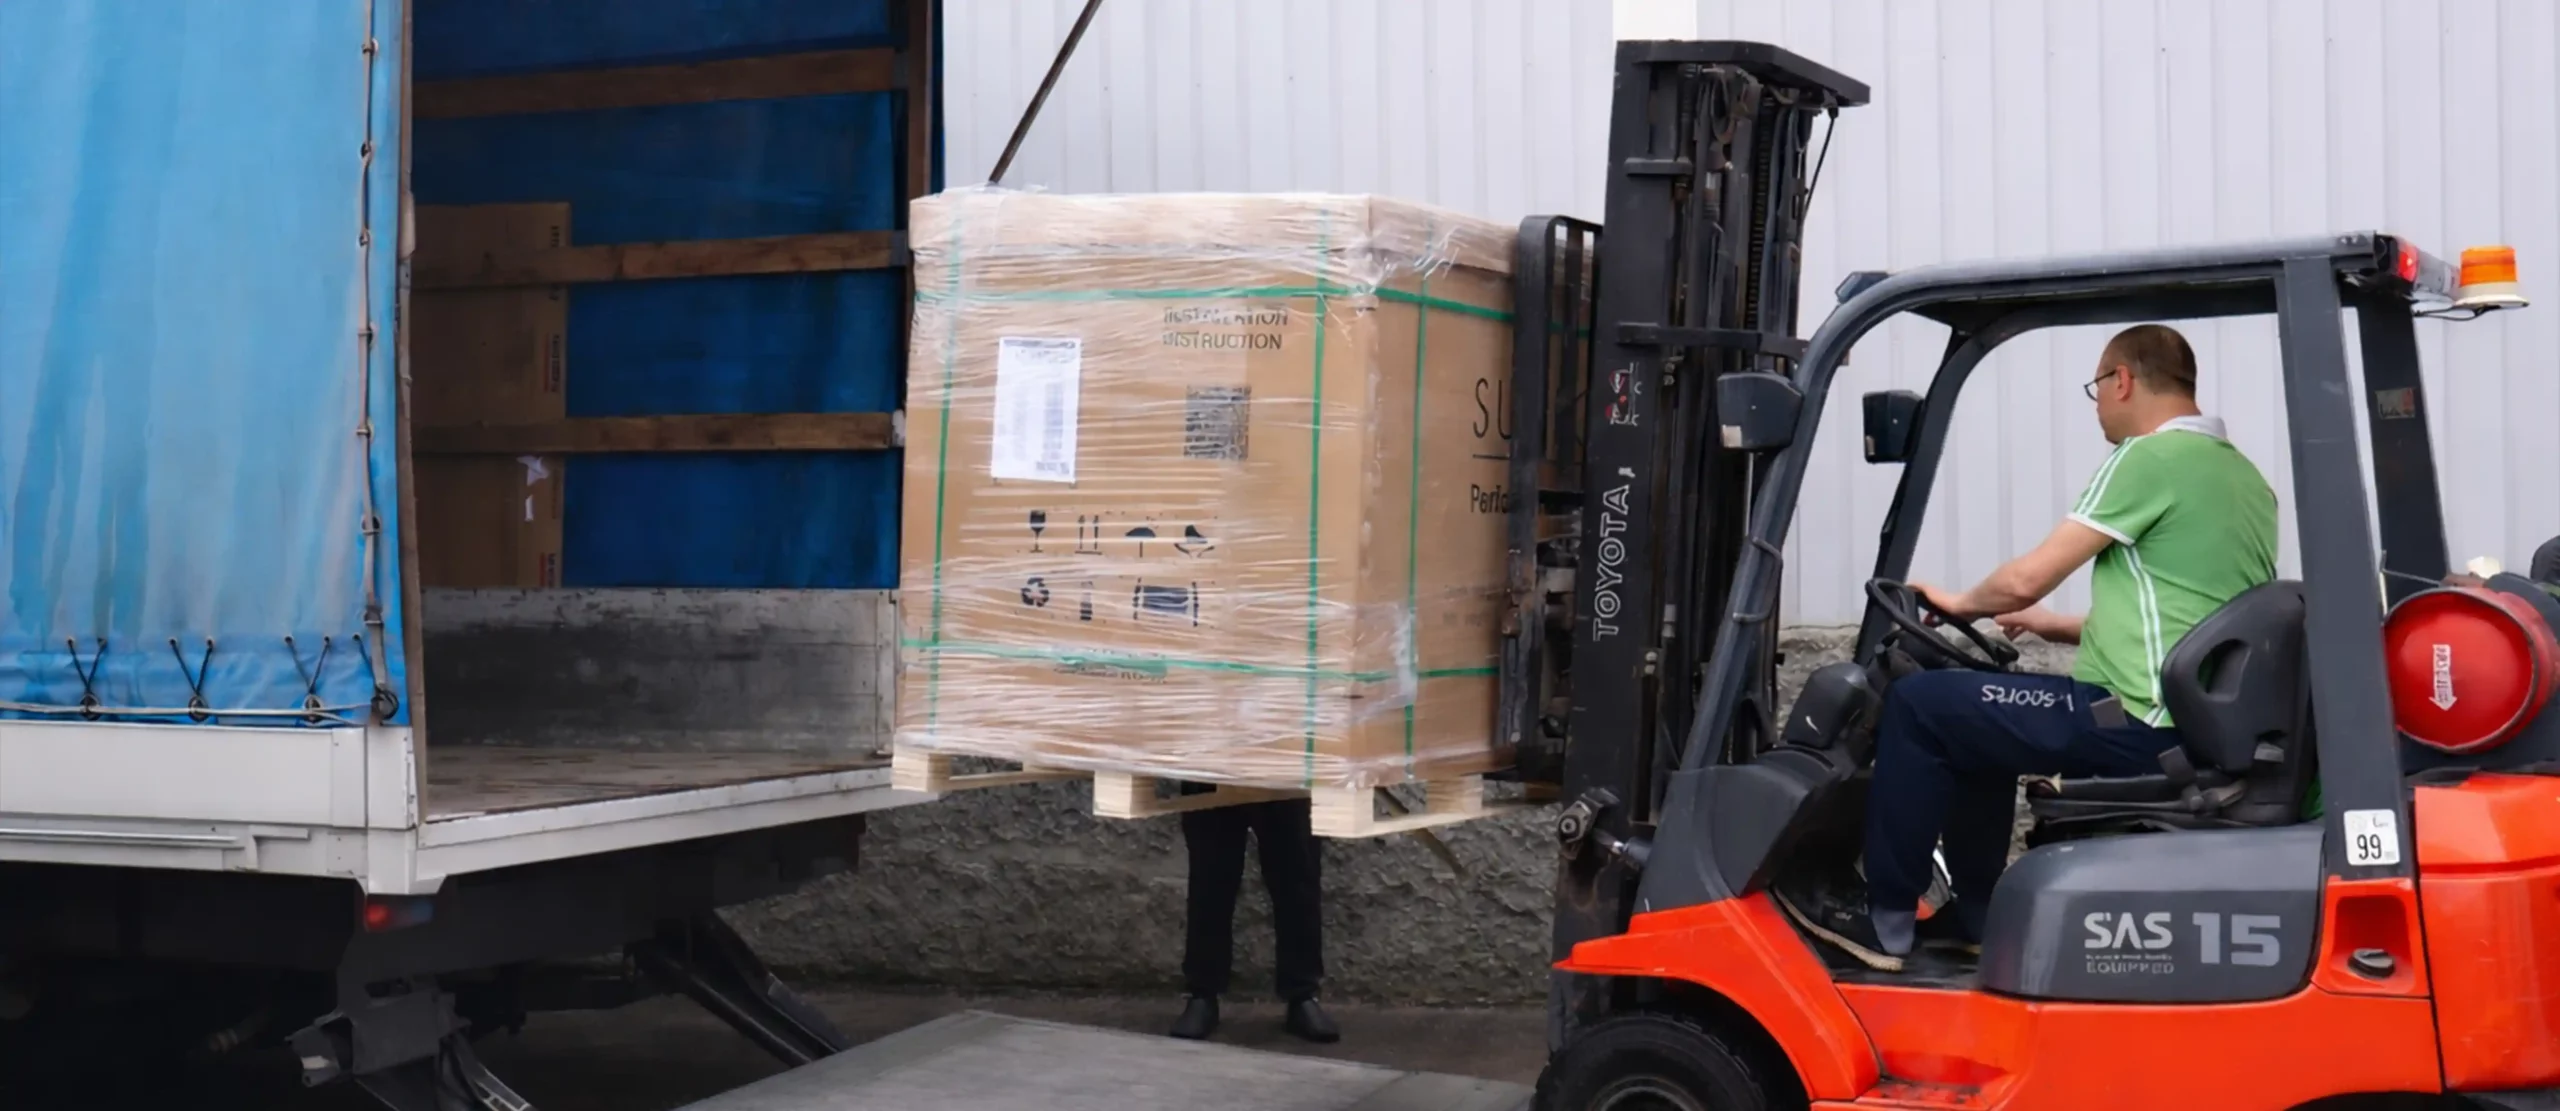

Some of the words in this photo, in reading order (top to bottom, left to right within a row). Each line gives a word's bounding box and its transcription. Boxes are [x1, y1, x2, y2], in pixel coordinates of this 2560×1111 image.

[1593, 484, 1629, 641] TOYOTA
[2357, 834, 2382, 860] 99
[2084, 912, 2173, 949] SAS
[2192, 912, 2280, 967] 15
